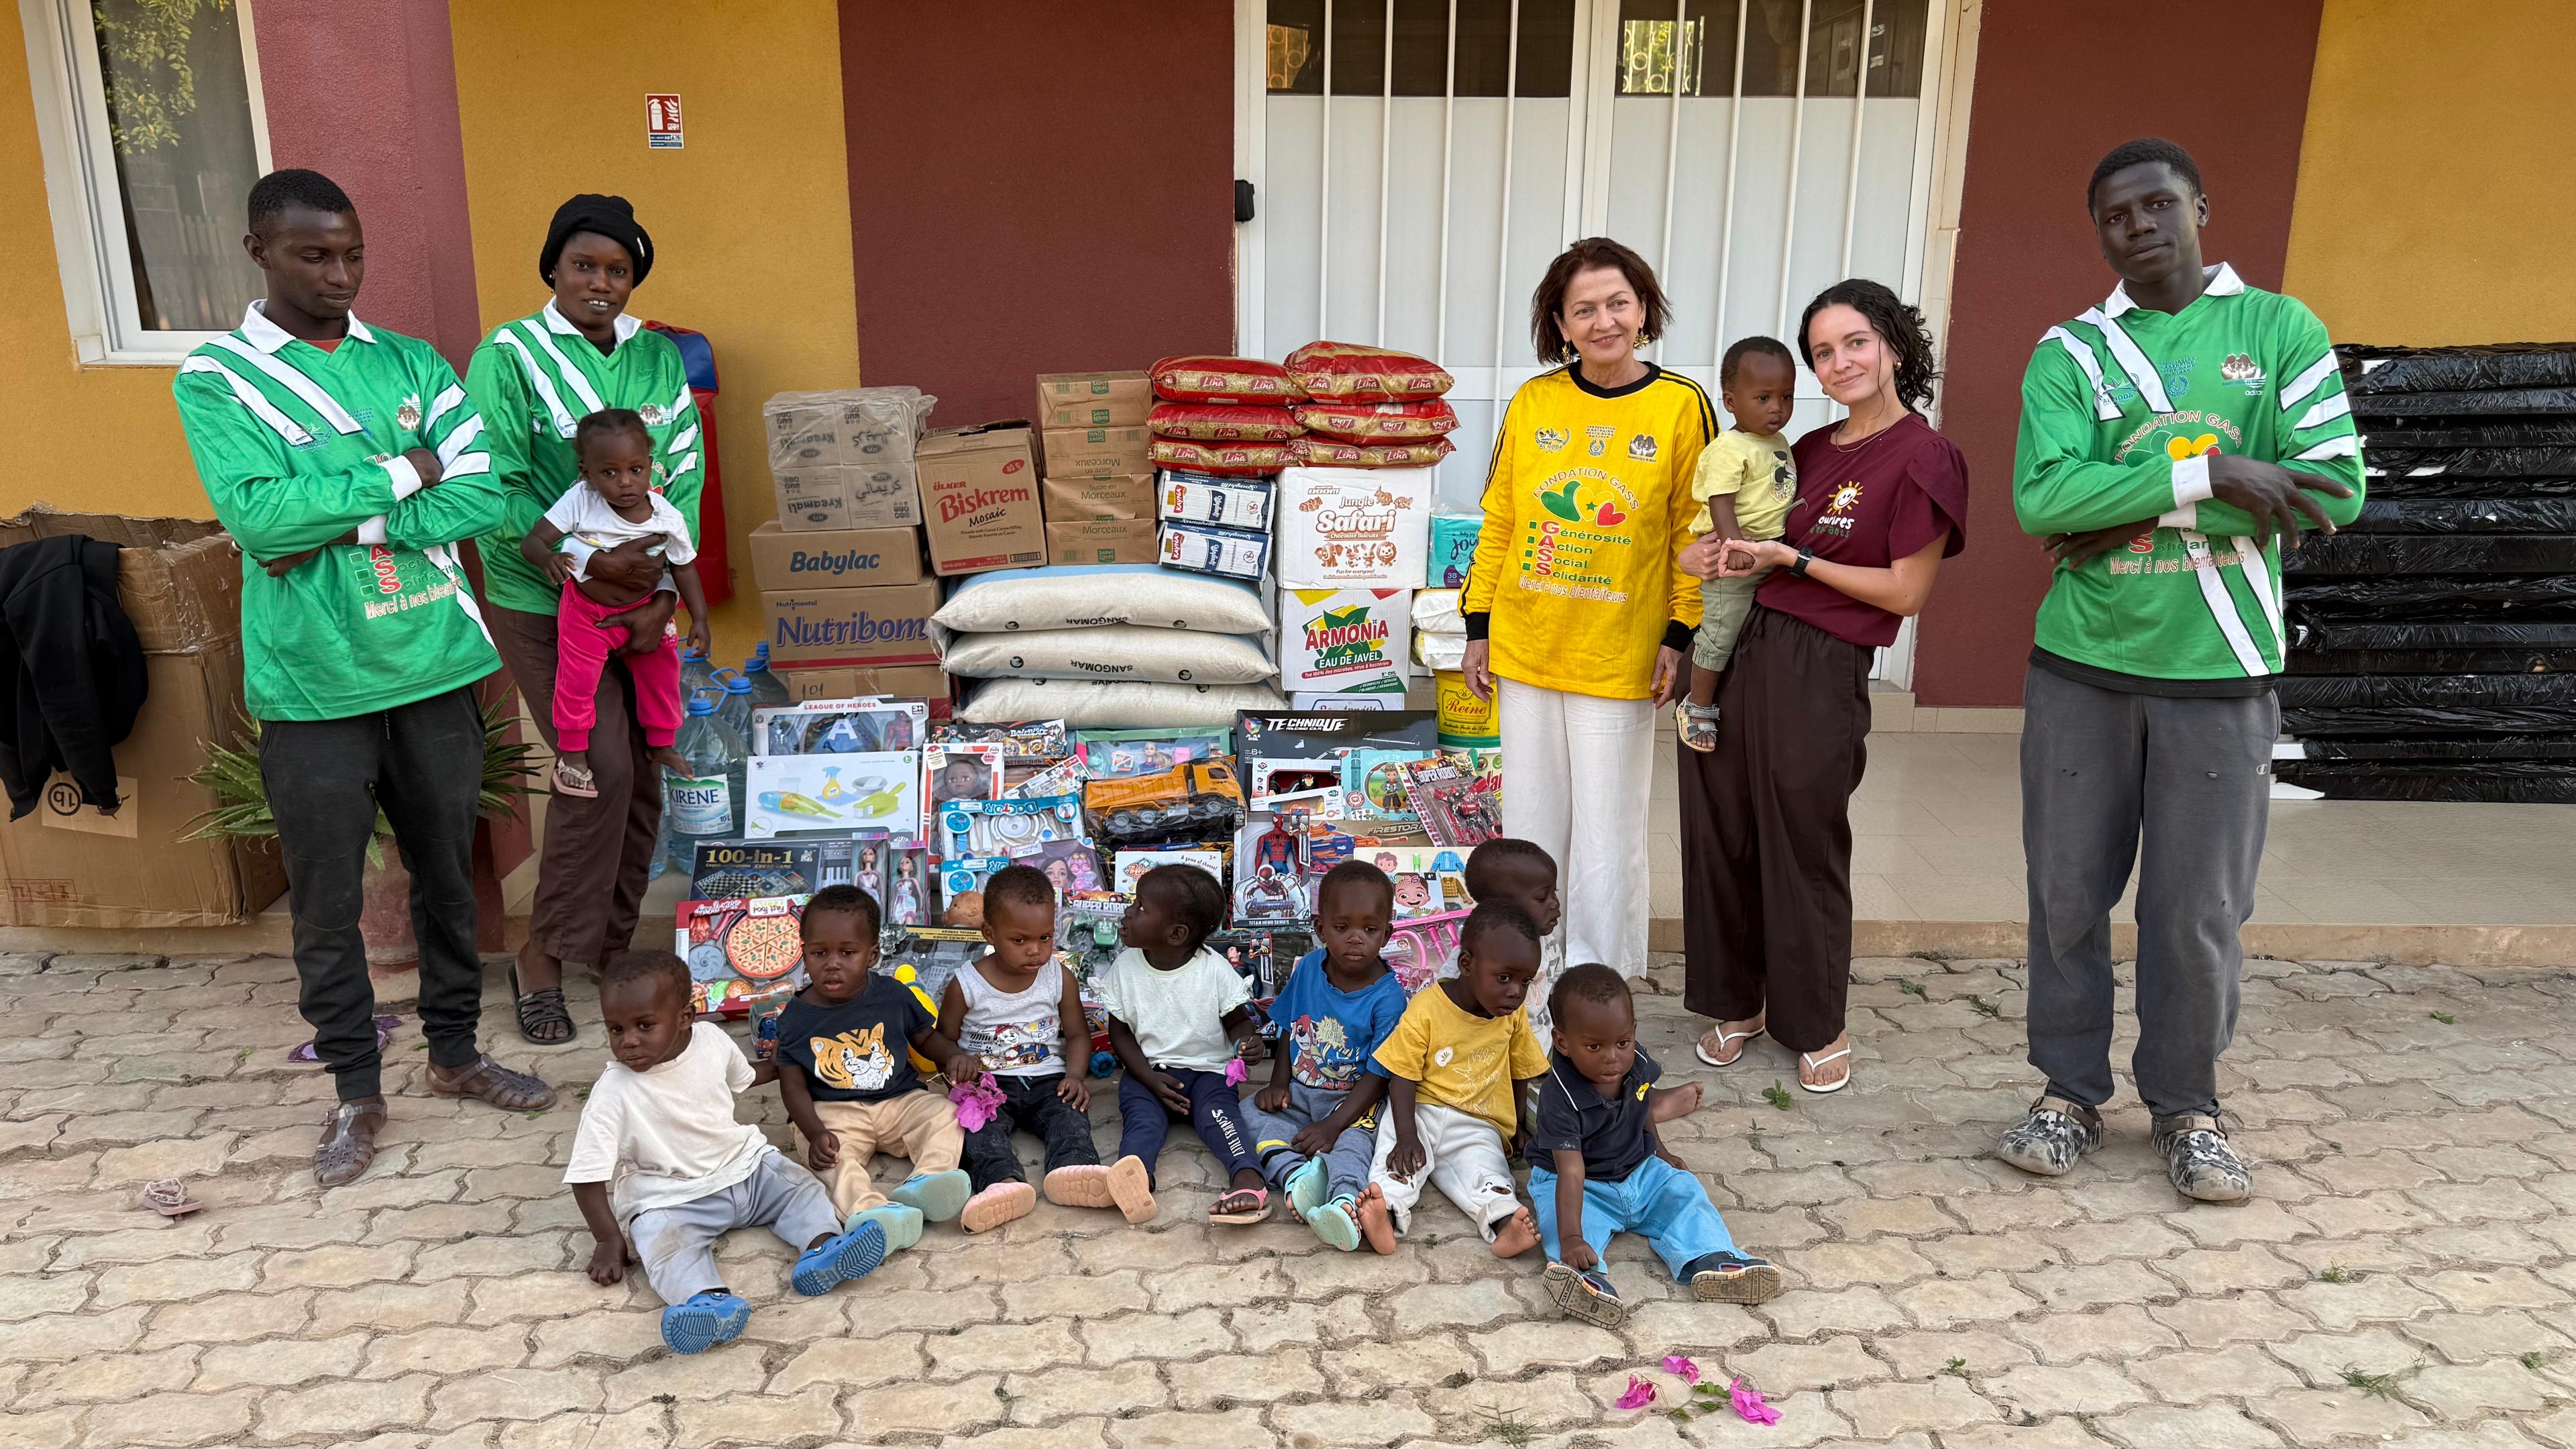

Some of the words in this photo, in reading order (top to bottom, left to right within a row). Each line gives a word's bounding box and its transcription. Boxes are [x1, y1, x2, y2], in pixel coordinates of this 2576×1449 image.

[1202, 378, 1224, 388] Lina
[1253, 380, 1274, 390] Lina
[1308, 378, 1328, 389] Lina
[1356, 378, 1378, 390] Lina
[1409, 378, 1432, 390] Lina
[1216, 429, 1238, 437] Lina
[2114, 411, 2201, 463] FONDATION
[1175, 449, 1197, 460] Lina
[1225, 453, 1246, 463] Lina
[1336, 451, 1358, 460] Lina
[1387, 452, 1409, 461] Lina
[1075, 458, 1120, 467] Morceaux
[933, 481, 967, 491] ÜLKER
[1532, 468, 1608, 499] FONDATION
[1609, 476, 1639, 511] GASS
[1081, 491, 1126, 500] Morceaux
[1339, 496, 1374, 508] Jungle
[933, 488, 1030, 523] Biskrem
[969, 507, 1006, 527] Mosaic
[1316, 509, 1396, 533] Safari
[1083, 525, 1127, 534] Morceaux
[1541, 521, 1631, 545] Générosité
[1538, 535, 1593, 555] Action
[790, 549, 880, 576] Babylac
[1536, 549, 1589, 569] Social
[2110, 556, 2142, 574] Merci
[2145, 556, 2153, 574] à
[2155, 557, 2178, 573] nos
[2182, 551, 2245, 572] bienfaiteurs
[379, 564, 454, 594] Solidarit
[1535, 562, 1612, 585] Solidarité
[1518, 574, 1543, 591] Merci
[1552, 584, 1568, 596] nos
[1569, 585, 1627, 604] bienfaiteurs
[364, 595, 398, 619] Merci
[400, 593, 408, 610] à
[409, 590, 429, 608] nos
[777, 598, 817, 609] Nutrimental
[777, 611, 928, 647] Nutribom
[1071, 660, 1134, 672] SANGOMAR
[1320, 657, 1338, 669] EAU
[1340, 655, 1352, 665] DE
[1354, 652, 1380, 663] JAVEL
[1446, 698, 1487, 714] Reine
[1265, 718, 1349, 731] TECHNIQUE
[1418, 771, 1437, 784] SUPER
[1438, 766, 1458, 780] ROBOT
[670, 789, 720, 804] KIRÈNE
[984, 802, 1038, 816] DOCTOR
[706, 849, 794, 865] 100-in-1
[753, 906, 769, 914] Food
[1073, 900, 1106, 911] SUPER
